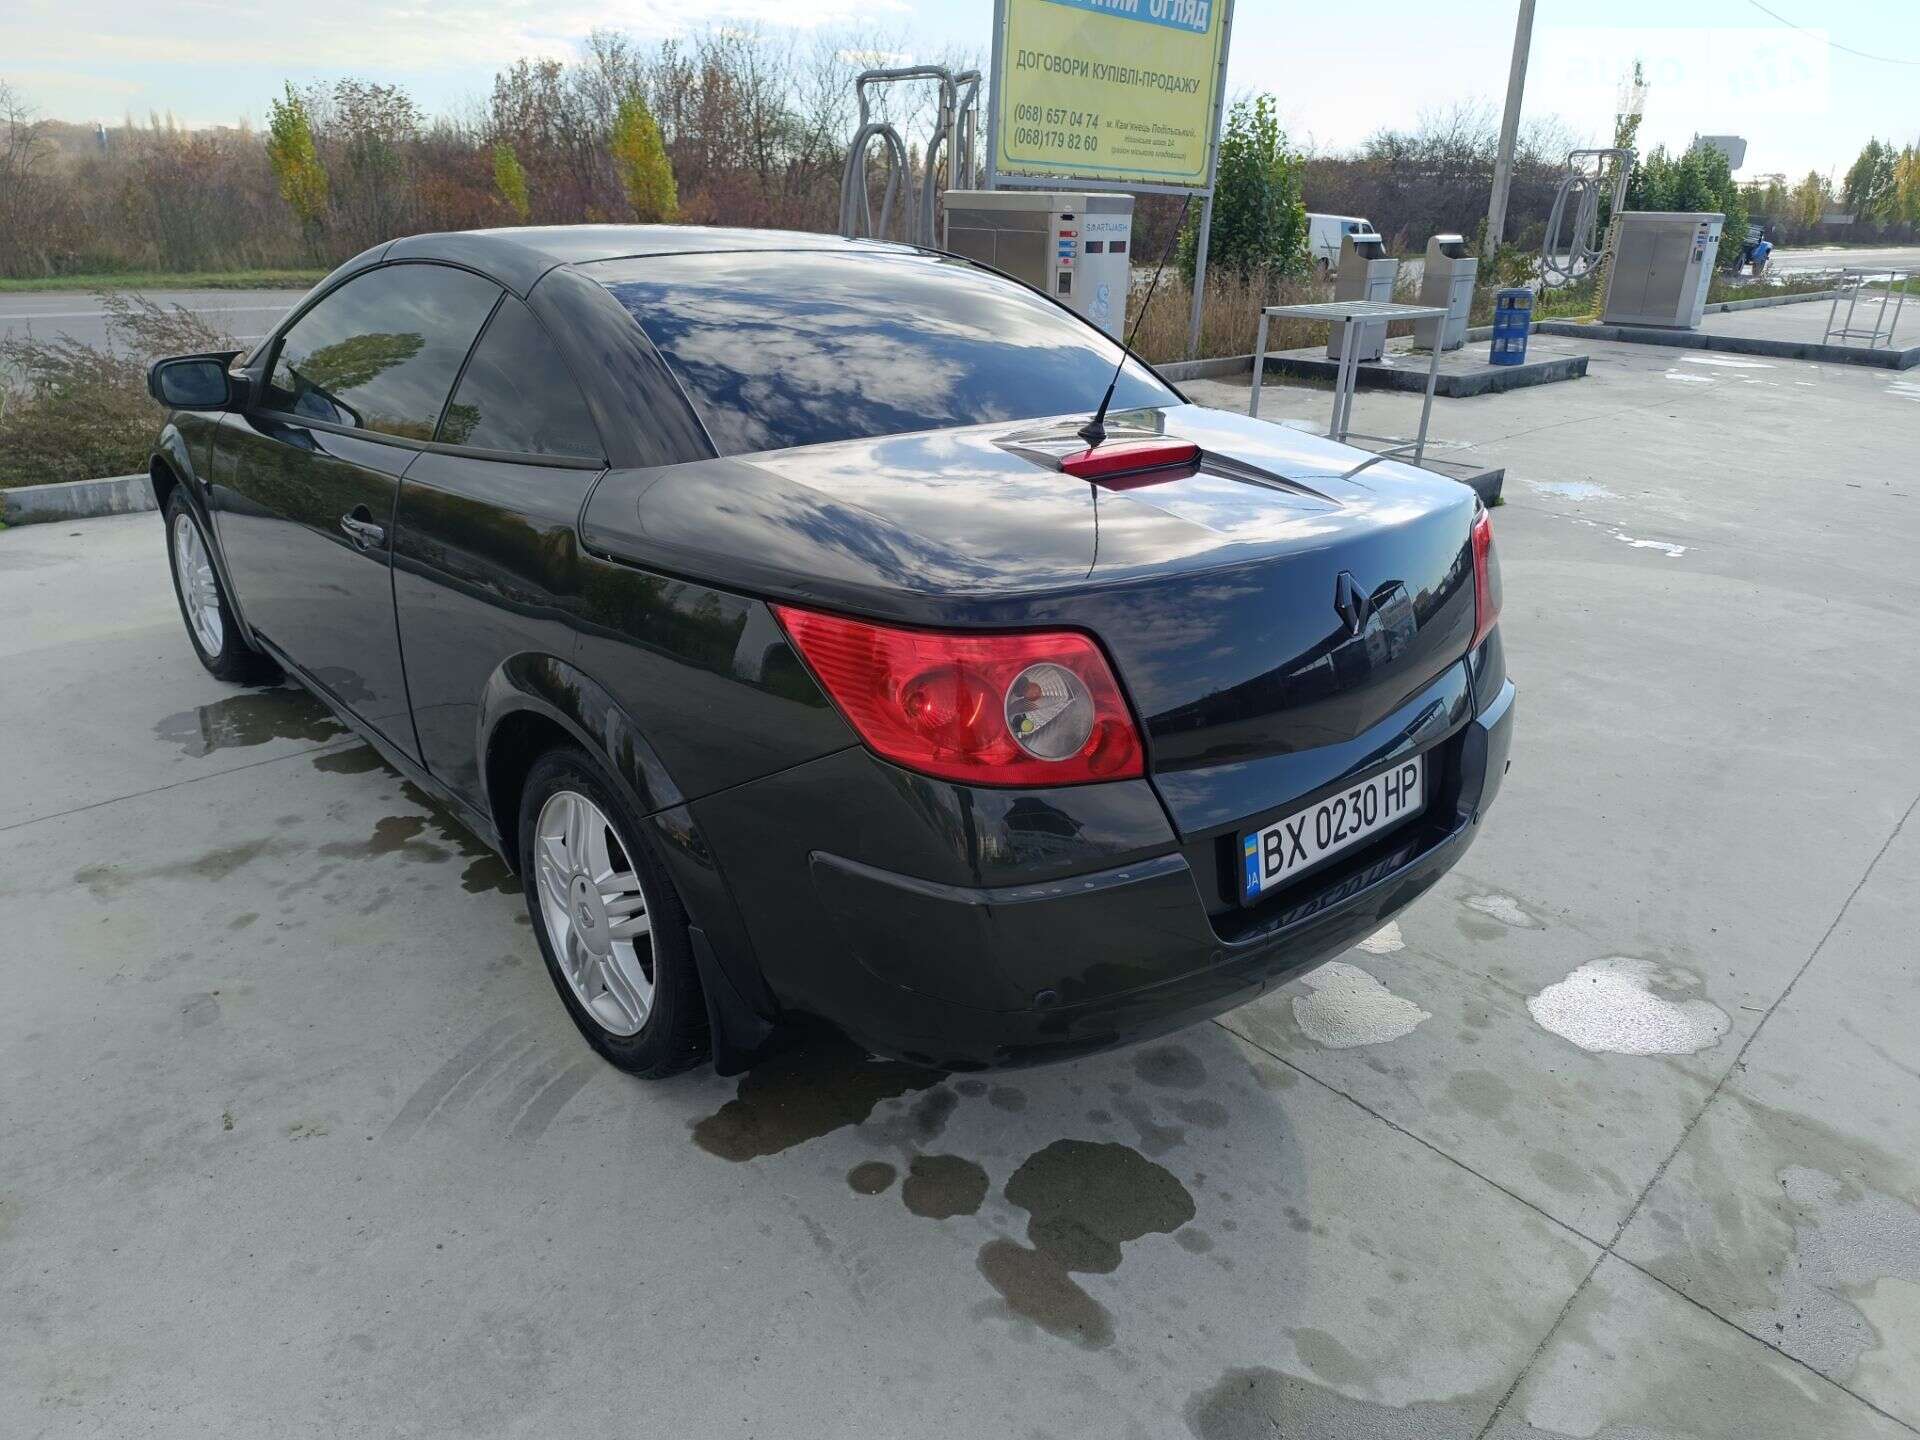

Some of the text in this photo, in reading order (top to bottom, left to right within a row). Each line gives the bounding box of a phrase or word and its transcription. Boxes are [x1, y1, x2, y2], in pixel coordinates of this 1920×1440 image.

[1016, 49, 1201, 94] ДОГОВОРИ КУПІВЛІ-ПРОДАЖУ
[1014, 103, 1099, 129] (068) 657 04 74
[1067, 133, 1081, 149] 82
[1084, 135, 1098, 151] 60
[1263, 763, 1418, 879] BX 0230 HP
